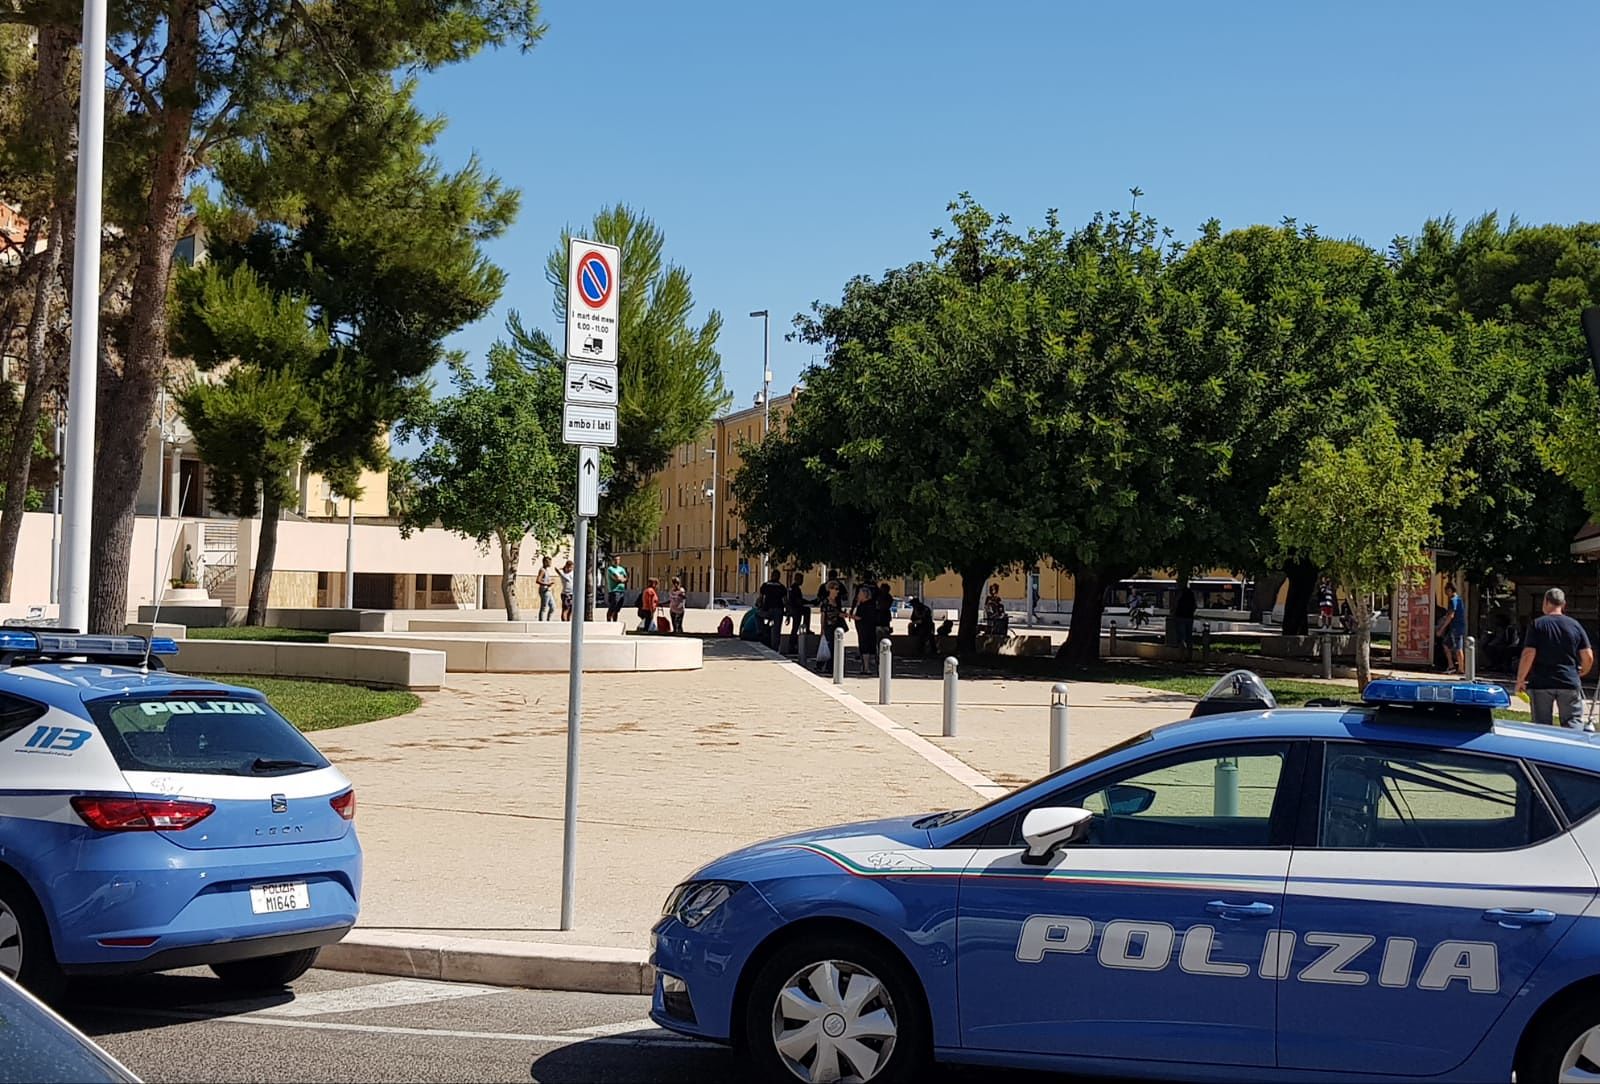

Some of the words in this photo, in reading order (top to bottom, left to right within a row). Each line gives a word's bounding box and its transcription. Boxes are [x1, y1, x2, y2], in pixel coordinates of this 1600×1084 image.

[568, 418, 591, 429] ambo
[592, 419, 596, 429] i
[598, 420, 611, 430] lati
[139, 701, 267, 715] POLIZIA
[24, 725, 92, 751] 113
[263, 882, 295, 895] POLIZIA
[266, 895, 297, 911] M1646
[1015, 914, 1500, 994] POLIZIA
